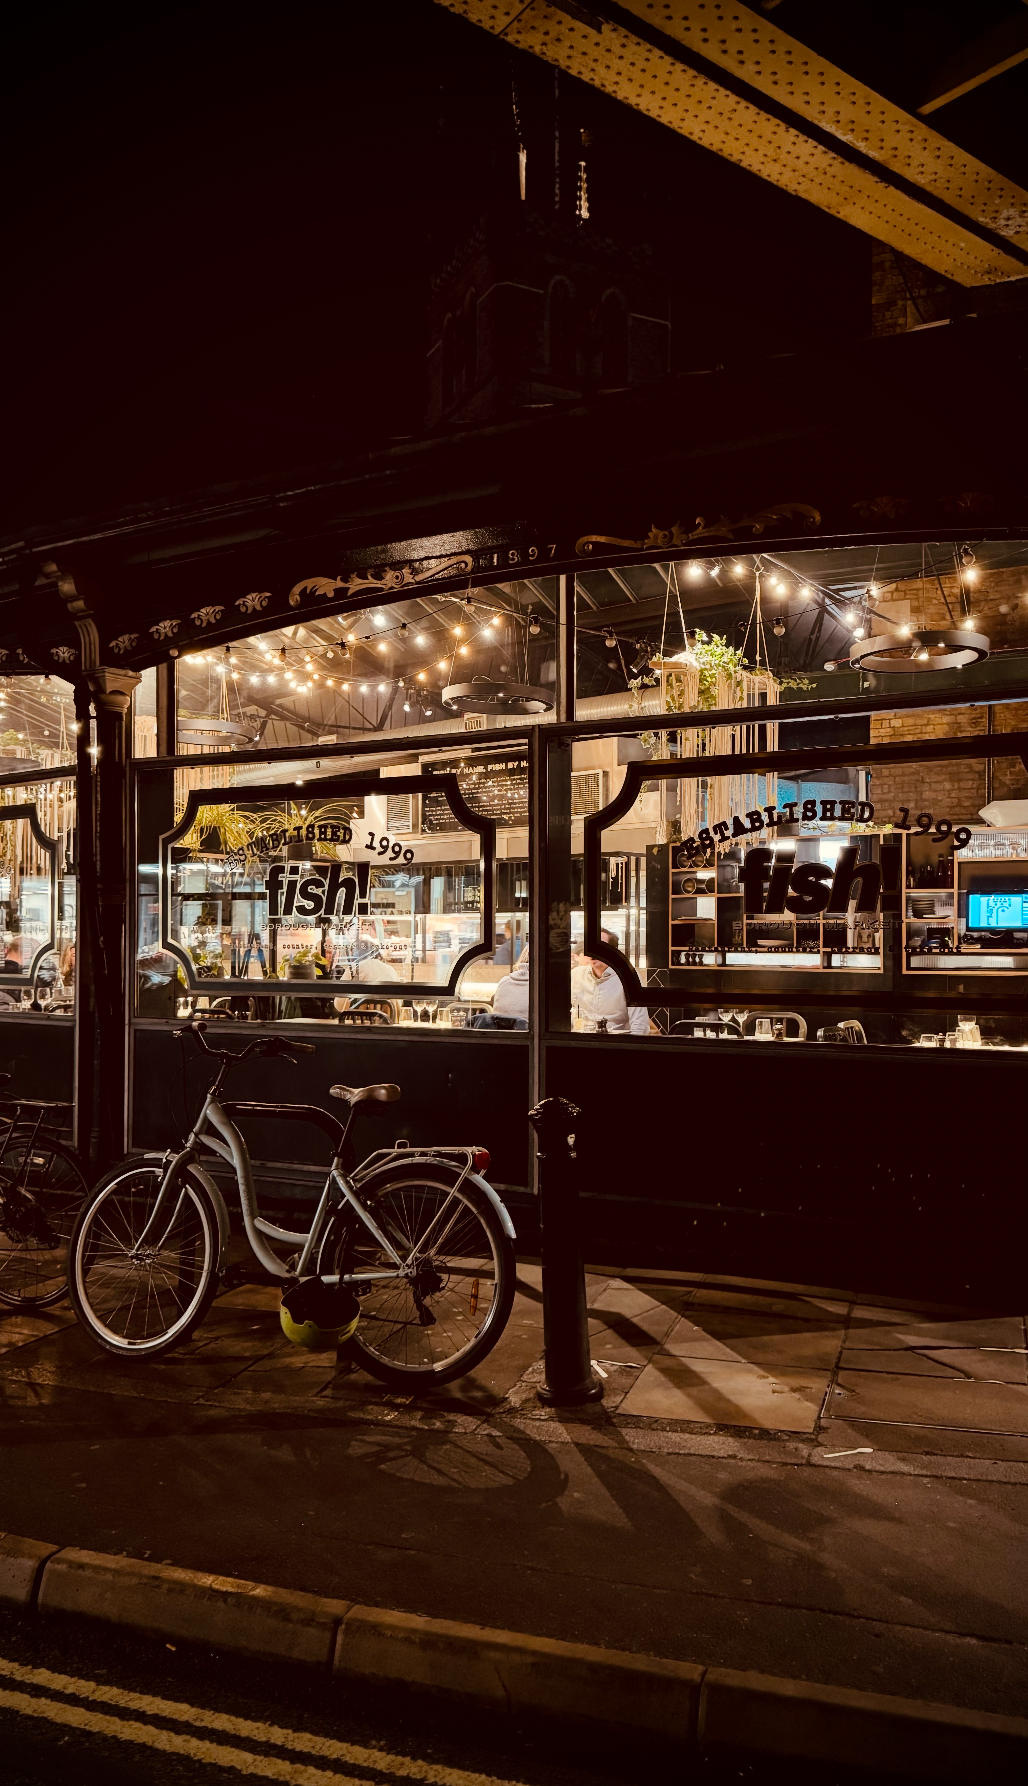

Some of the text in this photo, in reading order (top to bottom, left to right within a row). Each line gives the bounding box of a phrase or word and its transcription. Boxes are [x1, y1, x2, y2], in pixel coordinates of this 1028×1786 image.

[493, 544, 556, 566] 1897
[225, 824, 414, 871] ESTABLISHED 1999
[679, 799, 972, 860] ESTABLISHED 1999
[264, 861, 371, 918] fish!
[738, 843, 901, 914] fish!
[260, 922, 371, 931] BOROUGH MARKET
[825, 919, 904, 930] MARKET
